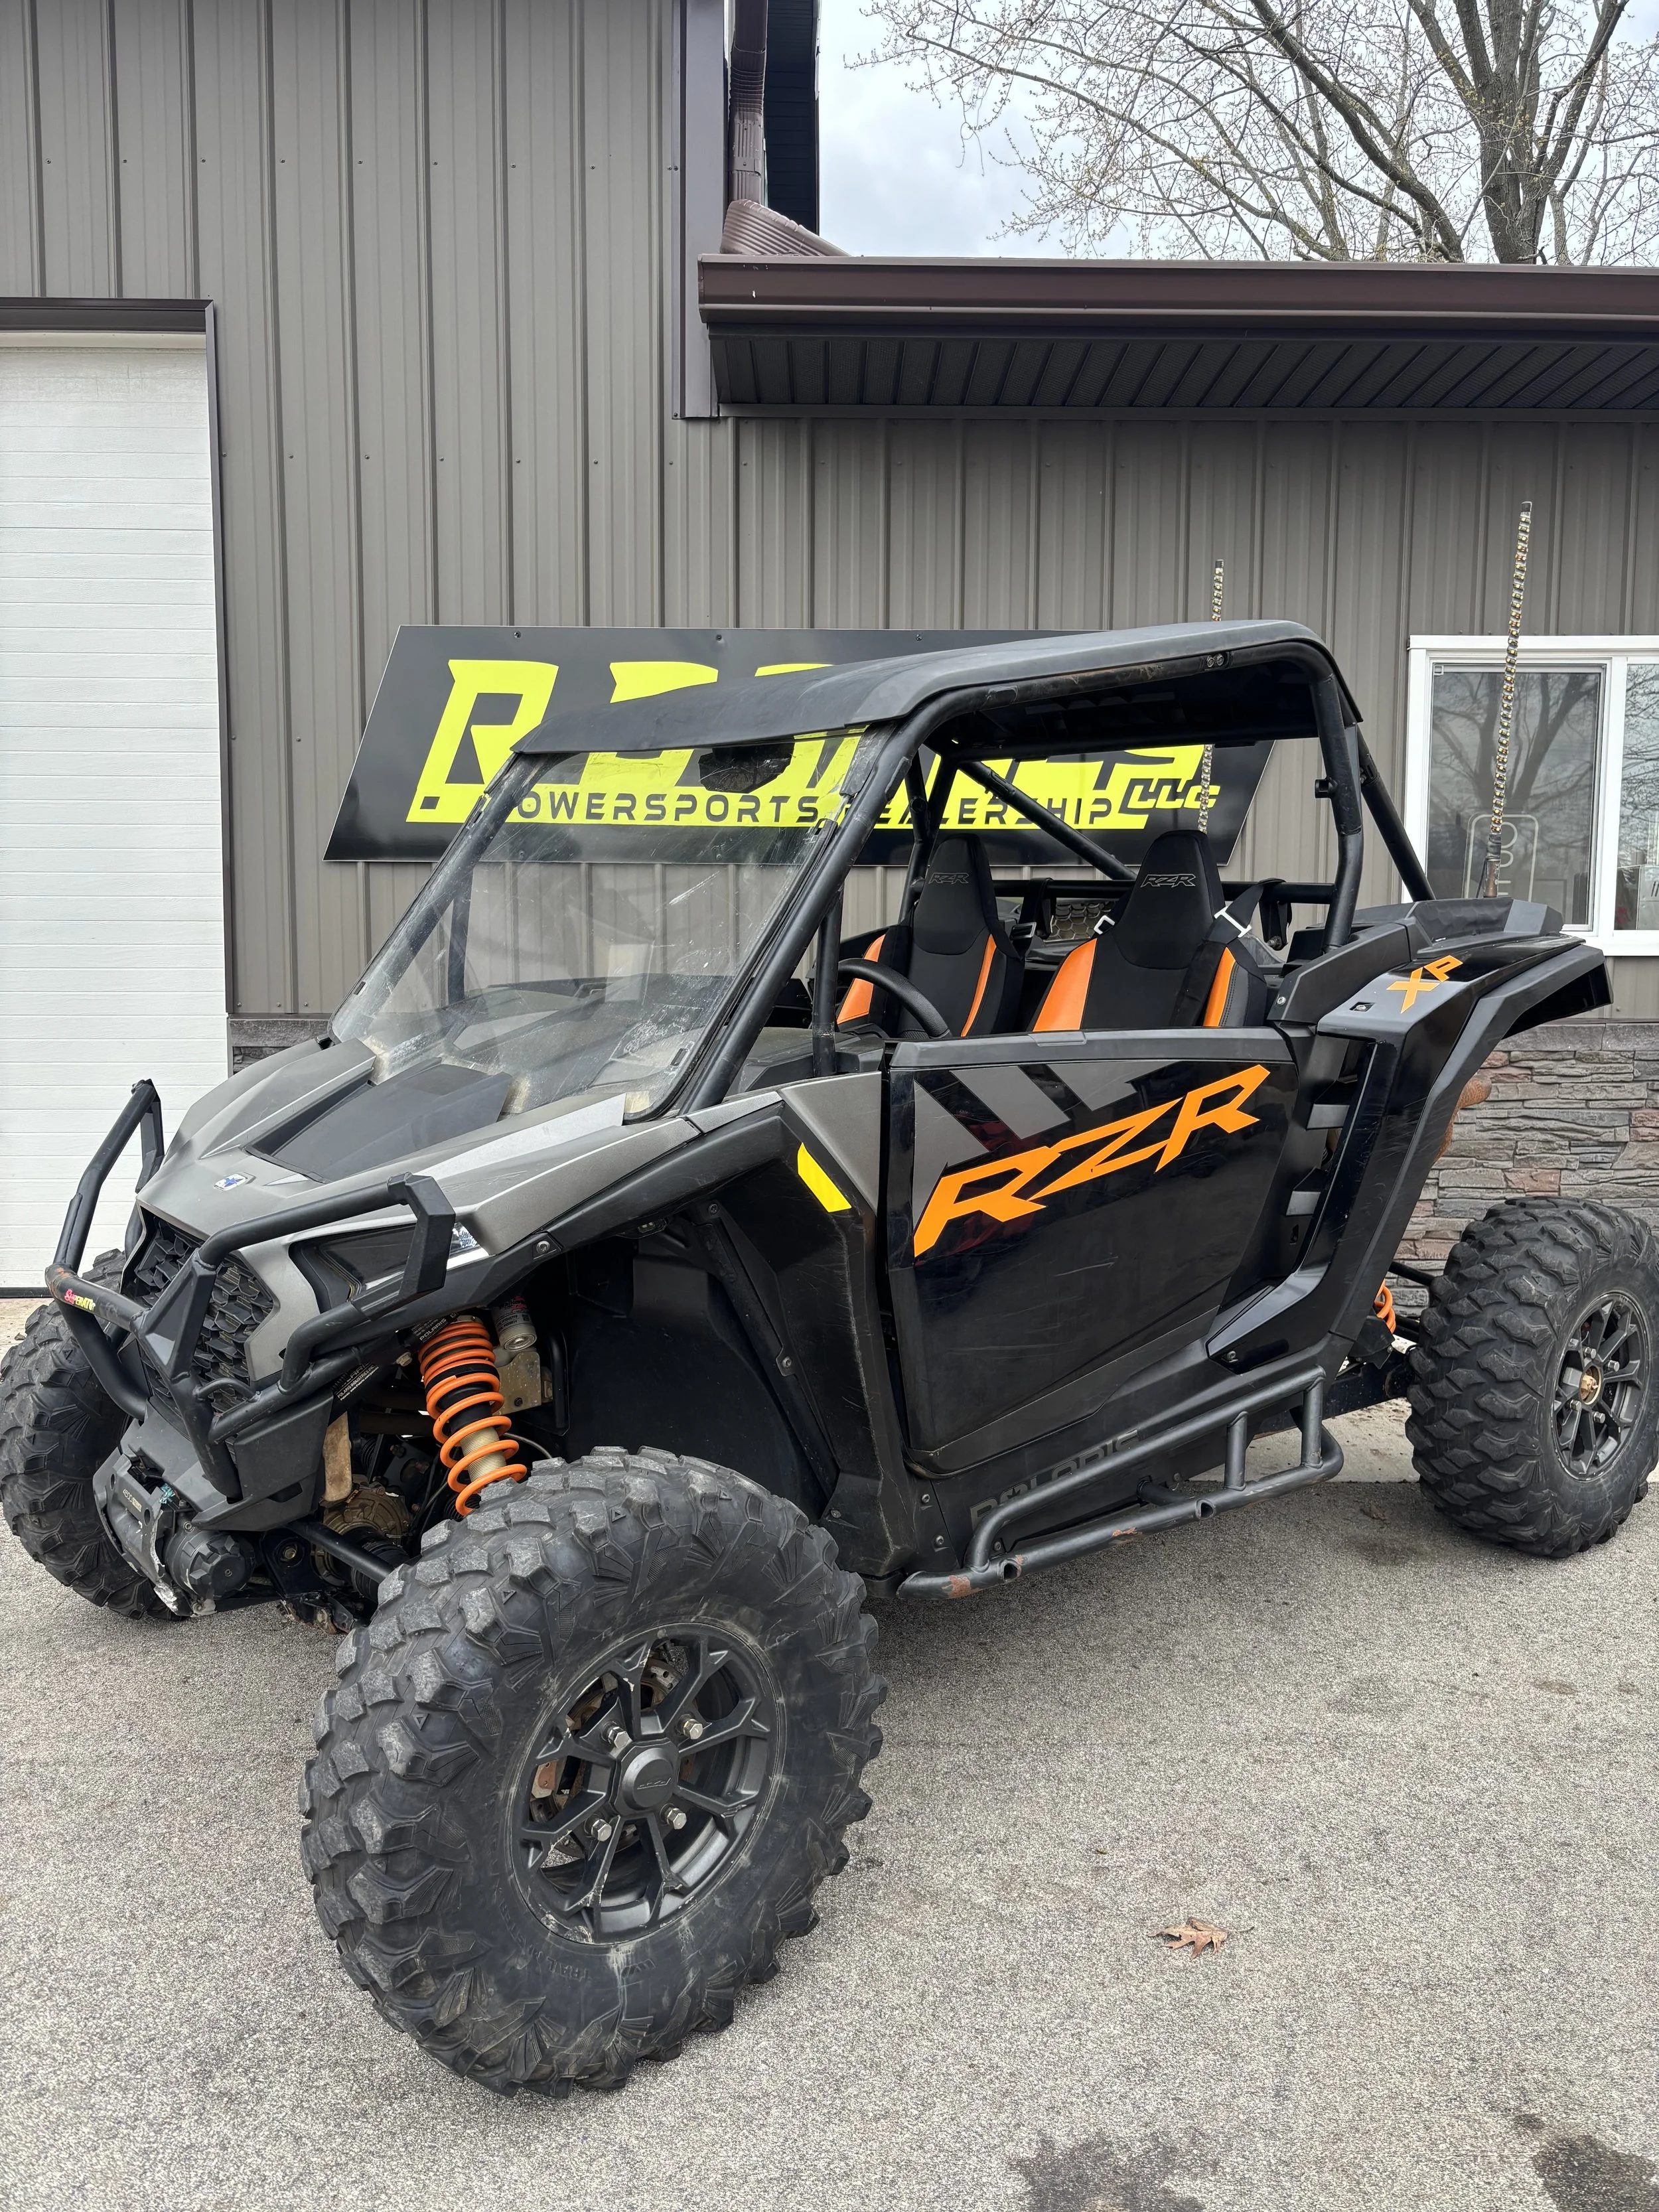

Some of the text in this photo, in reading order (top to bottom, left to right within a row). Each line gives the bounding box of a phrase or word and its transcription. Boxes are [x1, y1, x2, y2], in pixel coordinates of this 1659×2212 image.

[518, 791, 818, 824] OWERSPORTS
[1126, 784, 1221, 810] LLC
[928, 872, 970, 884] RZR
[1140, 873, 1196, 888] RZR
[1386, 954, 1463, 1014] XP
[914, 1065, 1270, 1258] RZR
